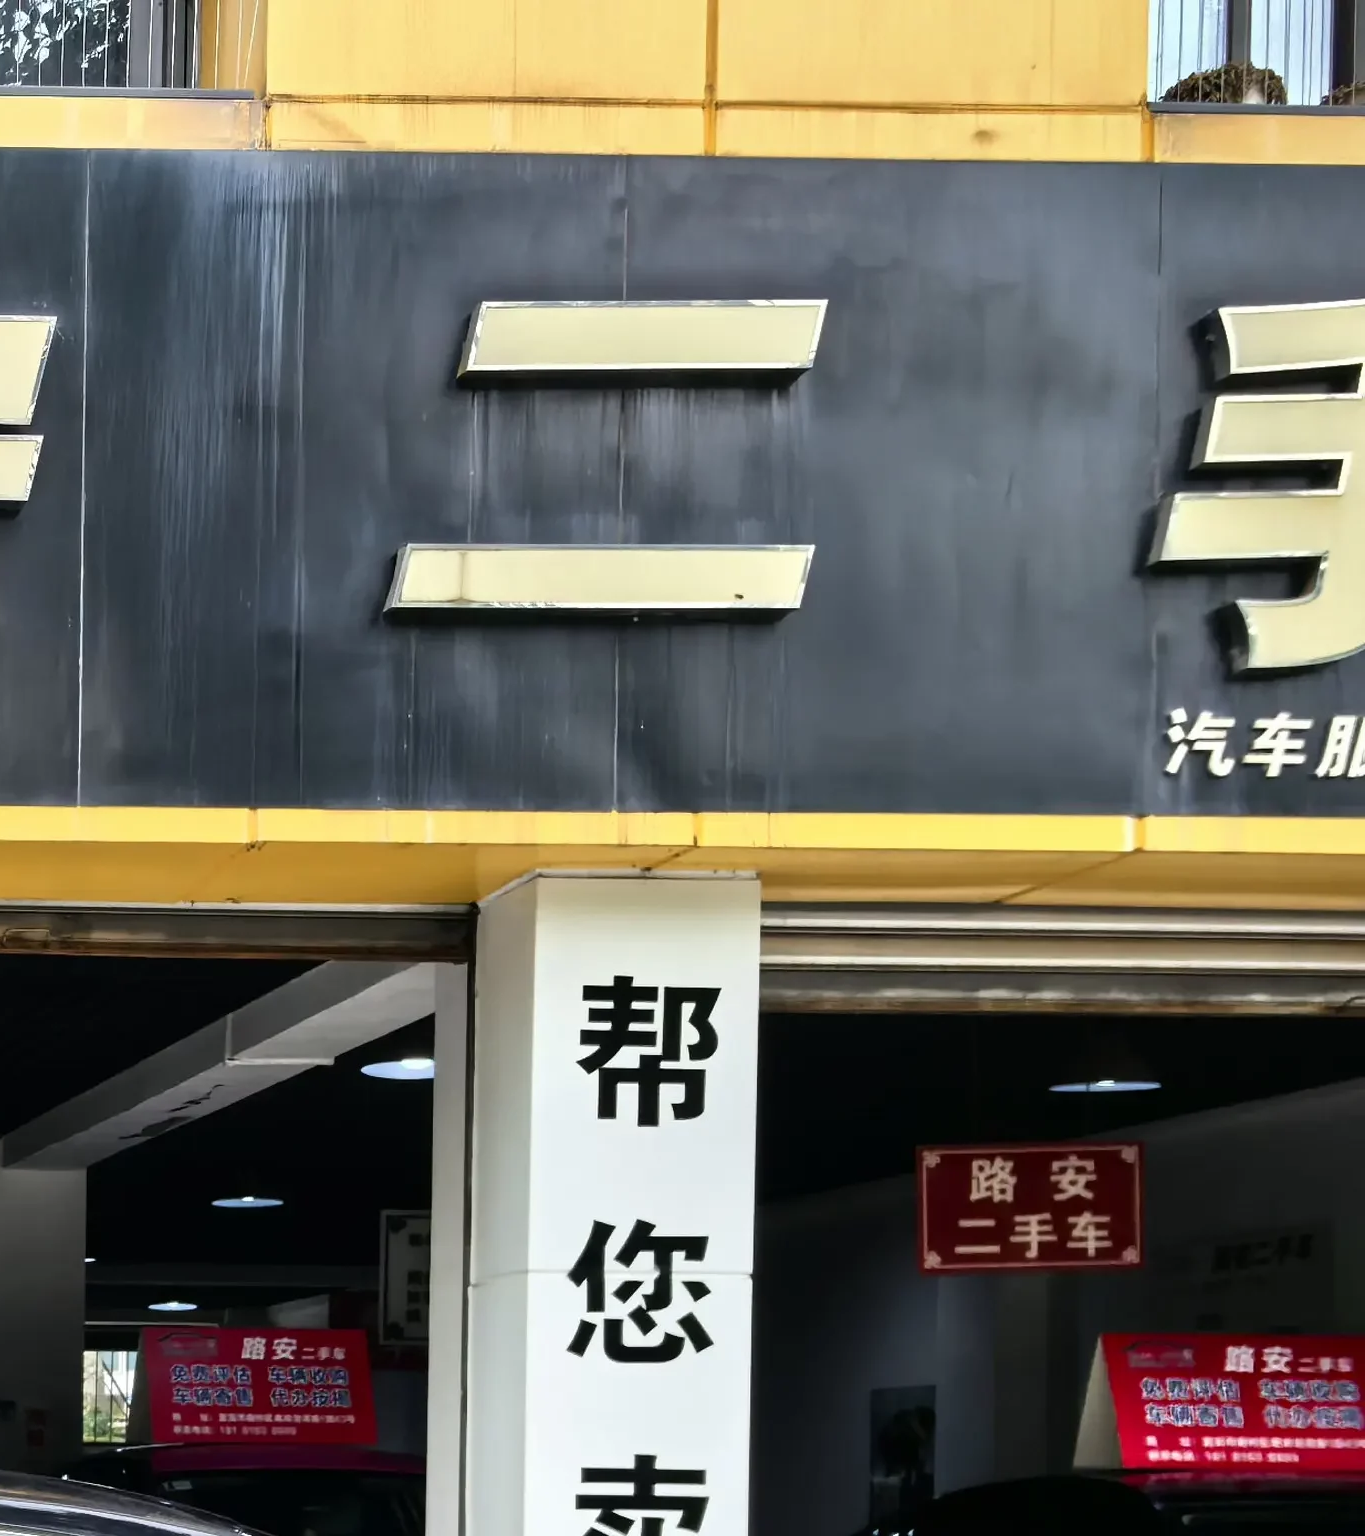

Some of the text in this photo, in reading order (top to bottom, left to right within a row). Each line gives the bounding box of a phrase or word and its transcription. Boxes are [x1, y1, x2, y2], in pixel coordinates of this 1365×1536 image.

[969, 1154, 1098, 1203] 路安
[954, 1211, 1113, 1258] 二手车
